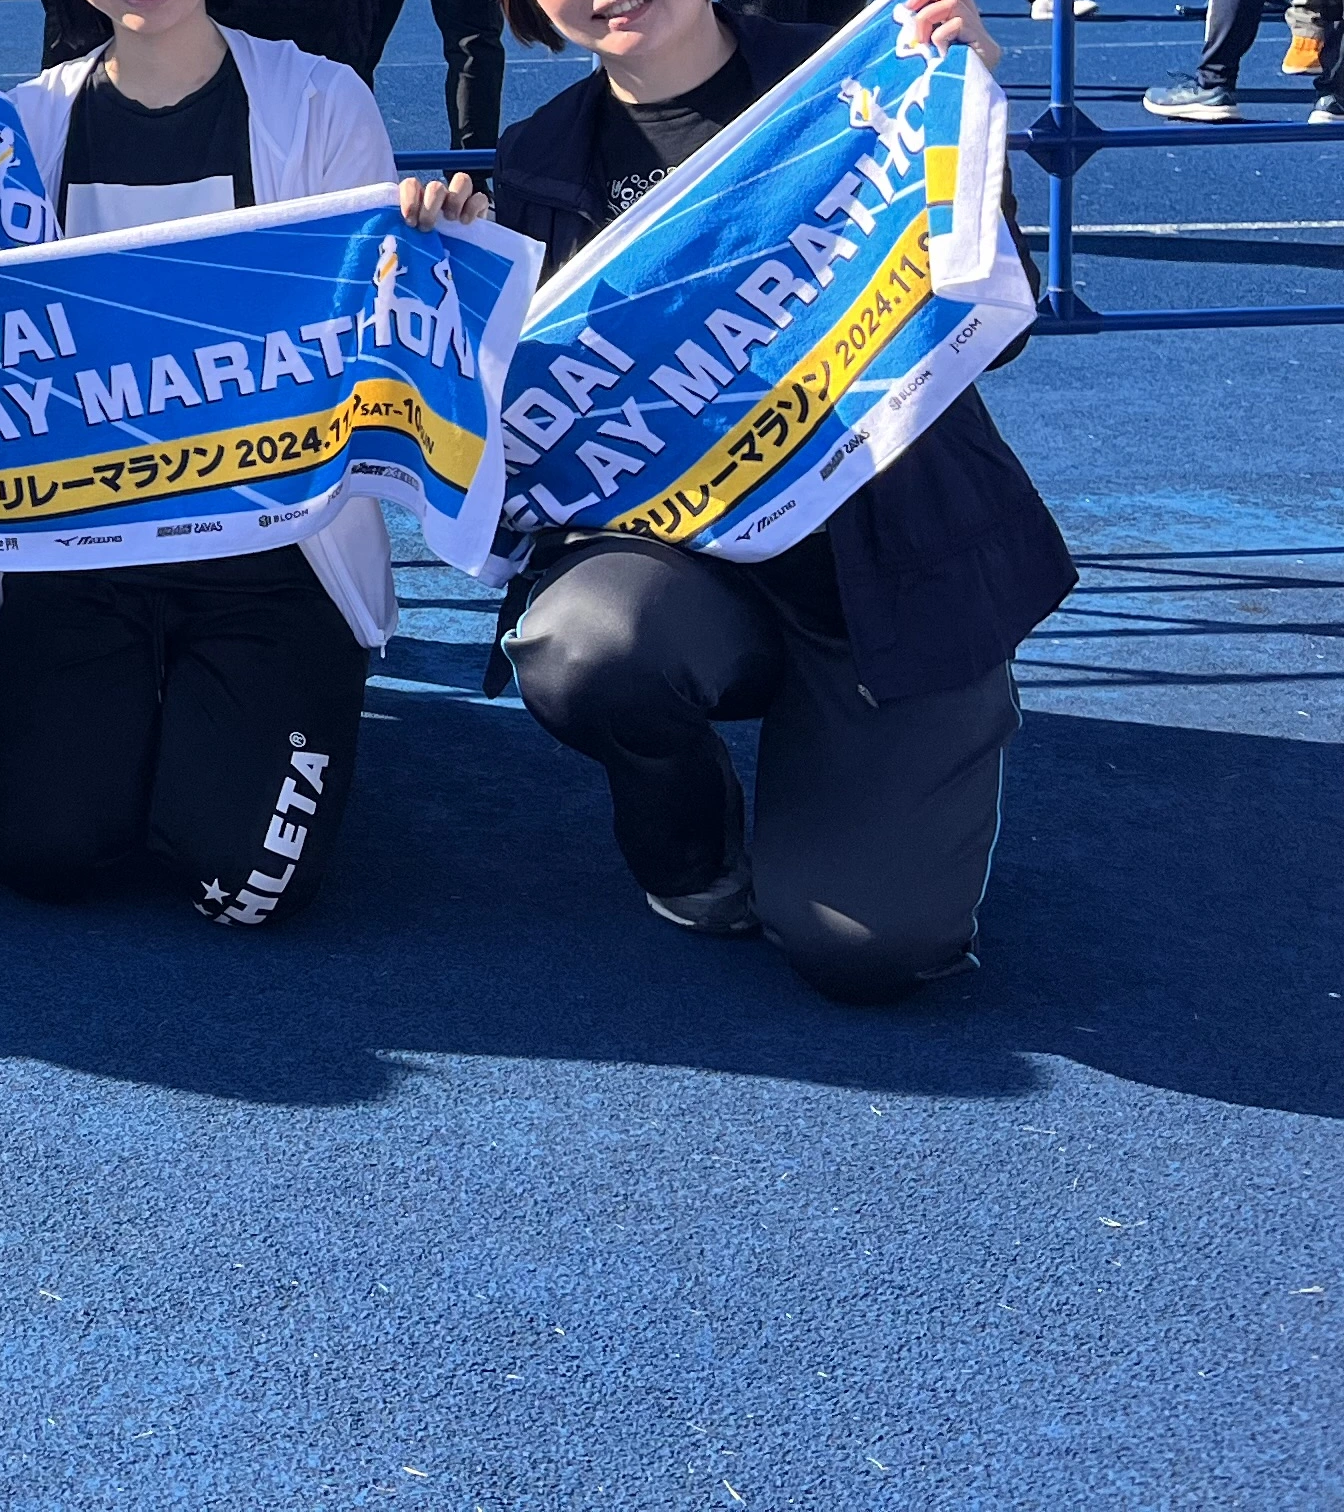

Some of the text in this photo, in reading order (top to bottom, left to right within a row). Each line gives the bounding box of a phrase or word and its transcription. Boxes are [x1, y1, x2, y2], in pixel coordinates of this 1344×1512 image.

[75, 296, 475, 425] MARATHON
[502, 66, 926, 532] ELAY MARATHO
[501, 326, 635, 476] NDAI
[619, 359, 831, 537] リレーマラソン
[212, 751, 330, 926] HLETA
